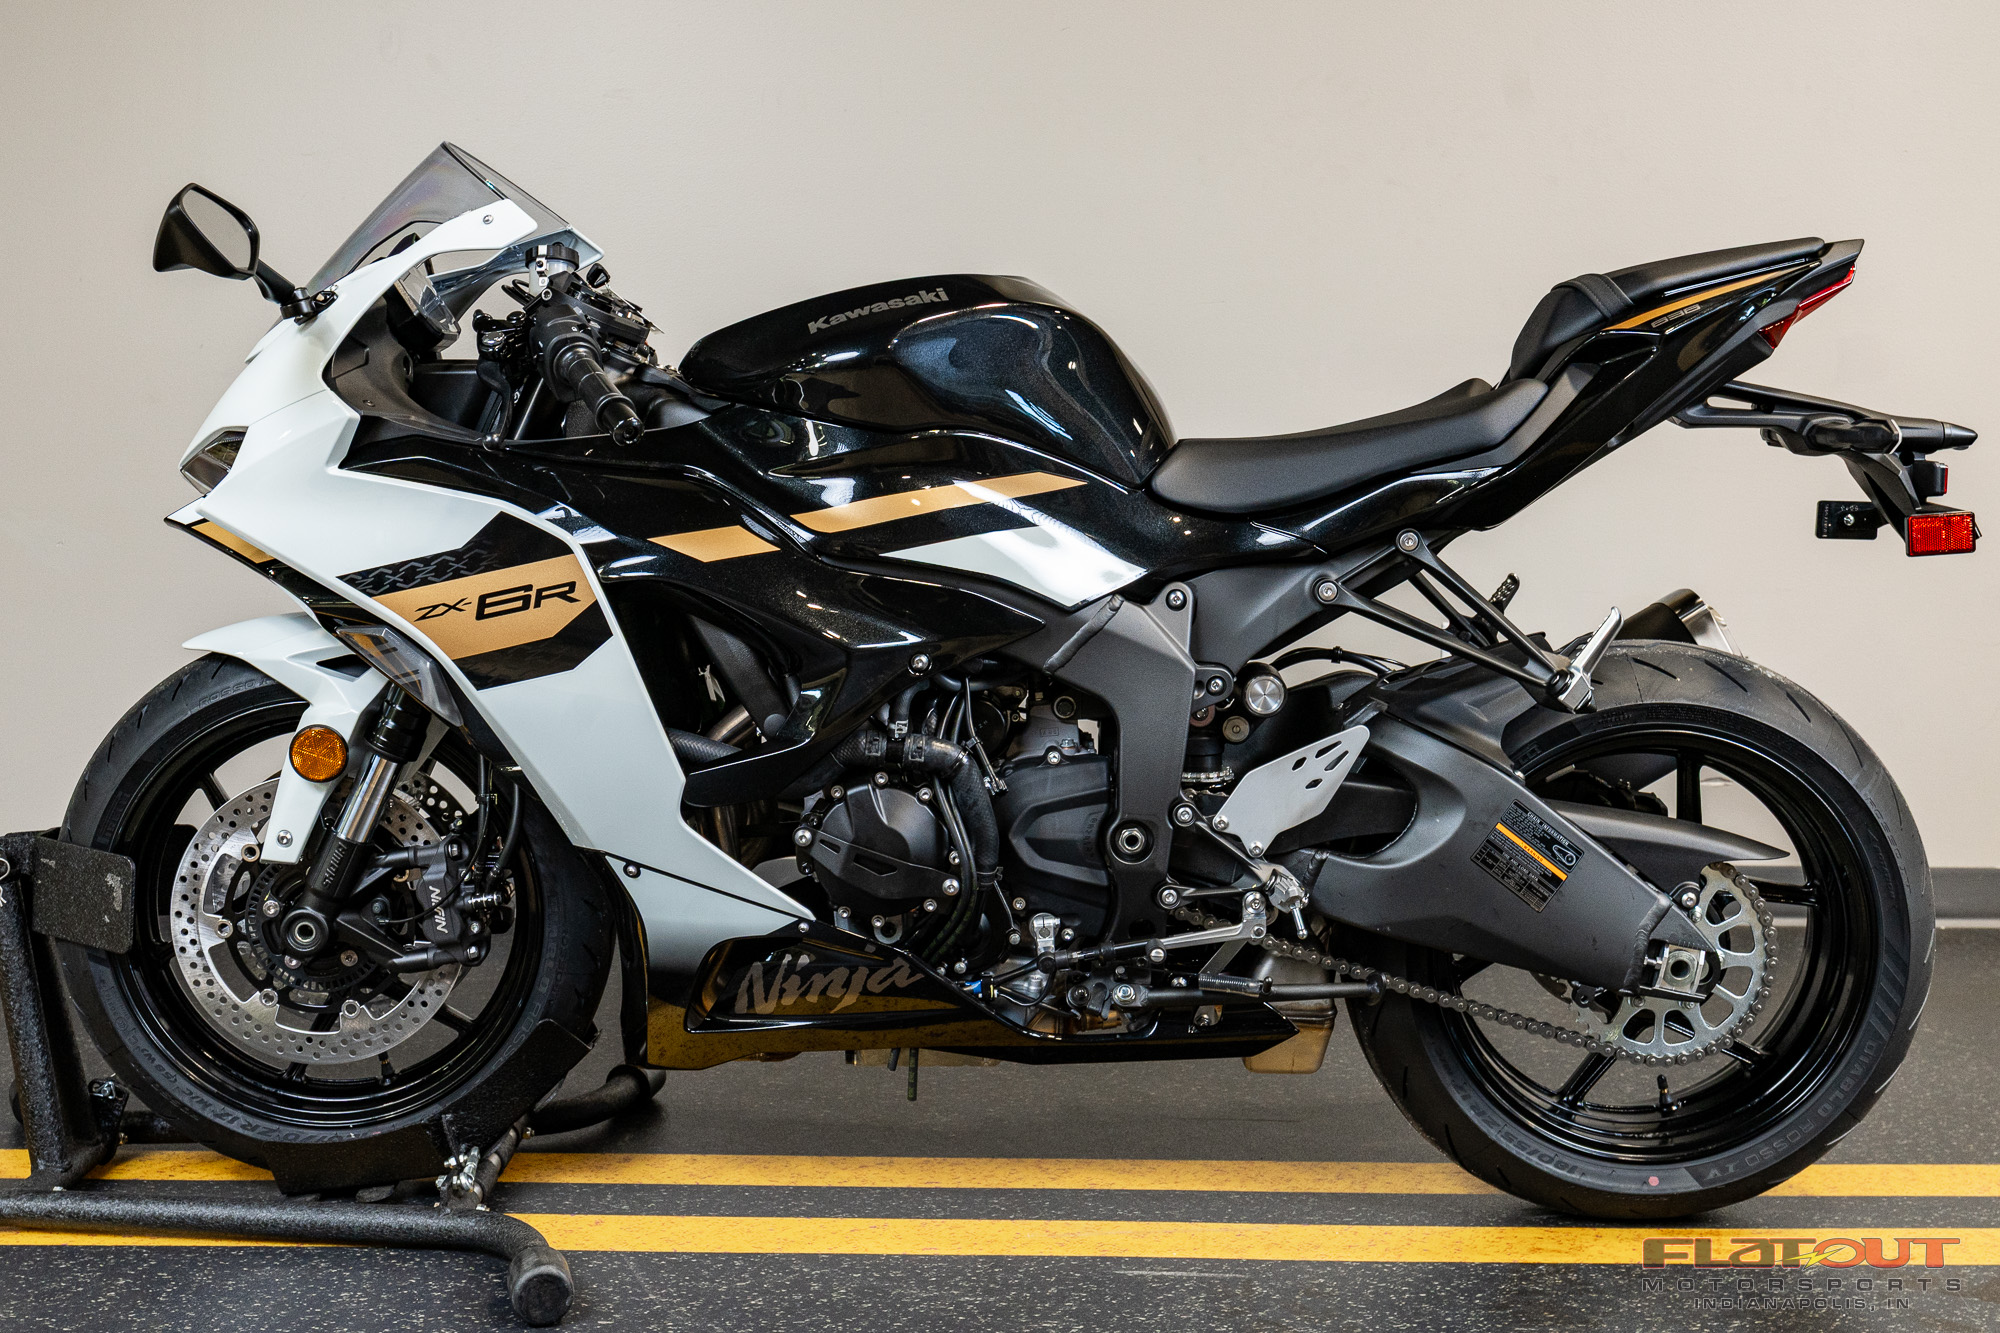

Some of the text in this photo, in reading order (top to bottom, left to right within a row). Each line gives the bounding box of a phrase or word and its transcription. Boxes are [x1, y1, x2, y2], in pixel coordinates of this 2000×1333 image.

[807, 287, 950, 335] Kawasaki
[413, 580, 582, 622] ZX-6R
[1526, 811, 1569, 846] CHAIN INFORMATION
[428, 885, 449, 934] NIIN
[734, 953, 925, 1015] Ninja
[1744, 1117, 1815, 1167] ROSSO
